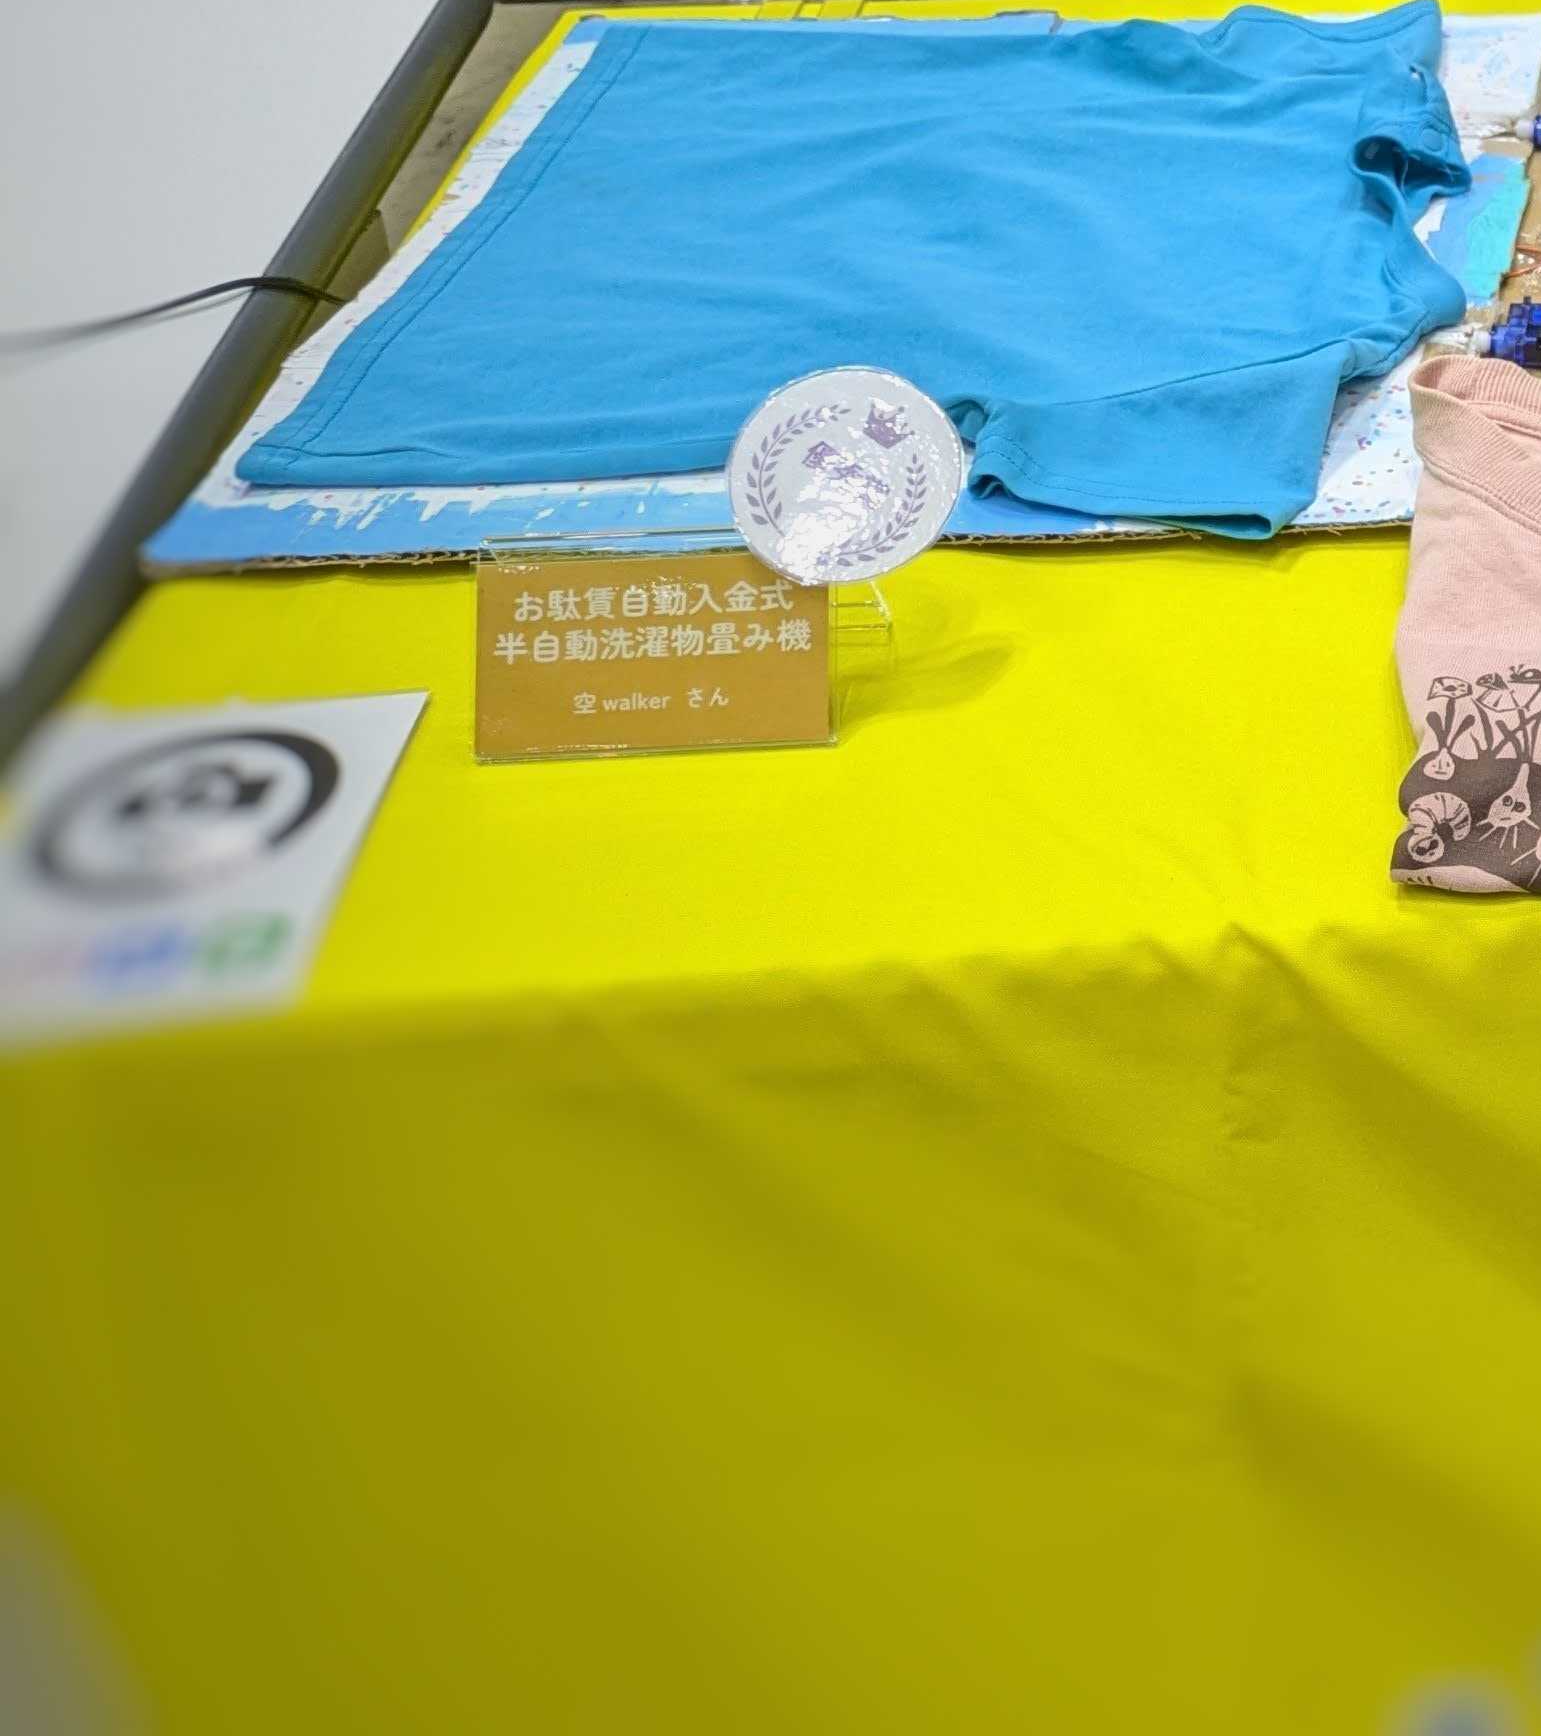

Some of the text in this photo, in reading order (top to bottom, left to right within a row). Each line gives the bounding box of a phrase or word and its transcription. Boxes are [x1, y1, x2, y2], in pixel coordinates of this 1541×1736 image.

[512, 579, 795, 624] お駄賃自動入金式
[493, 621, 813, 665] 半自動洗濯物畳み機
[686, 686, 730, 709] さん
